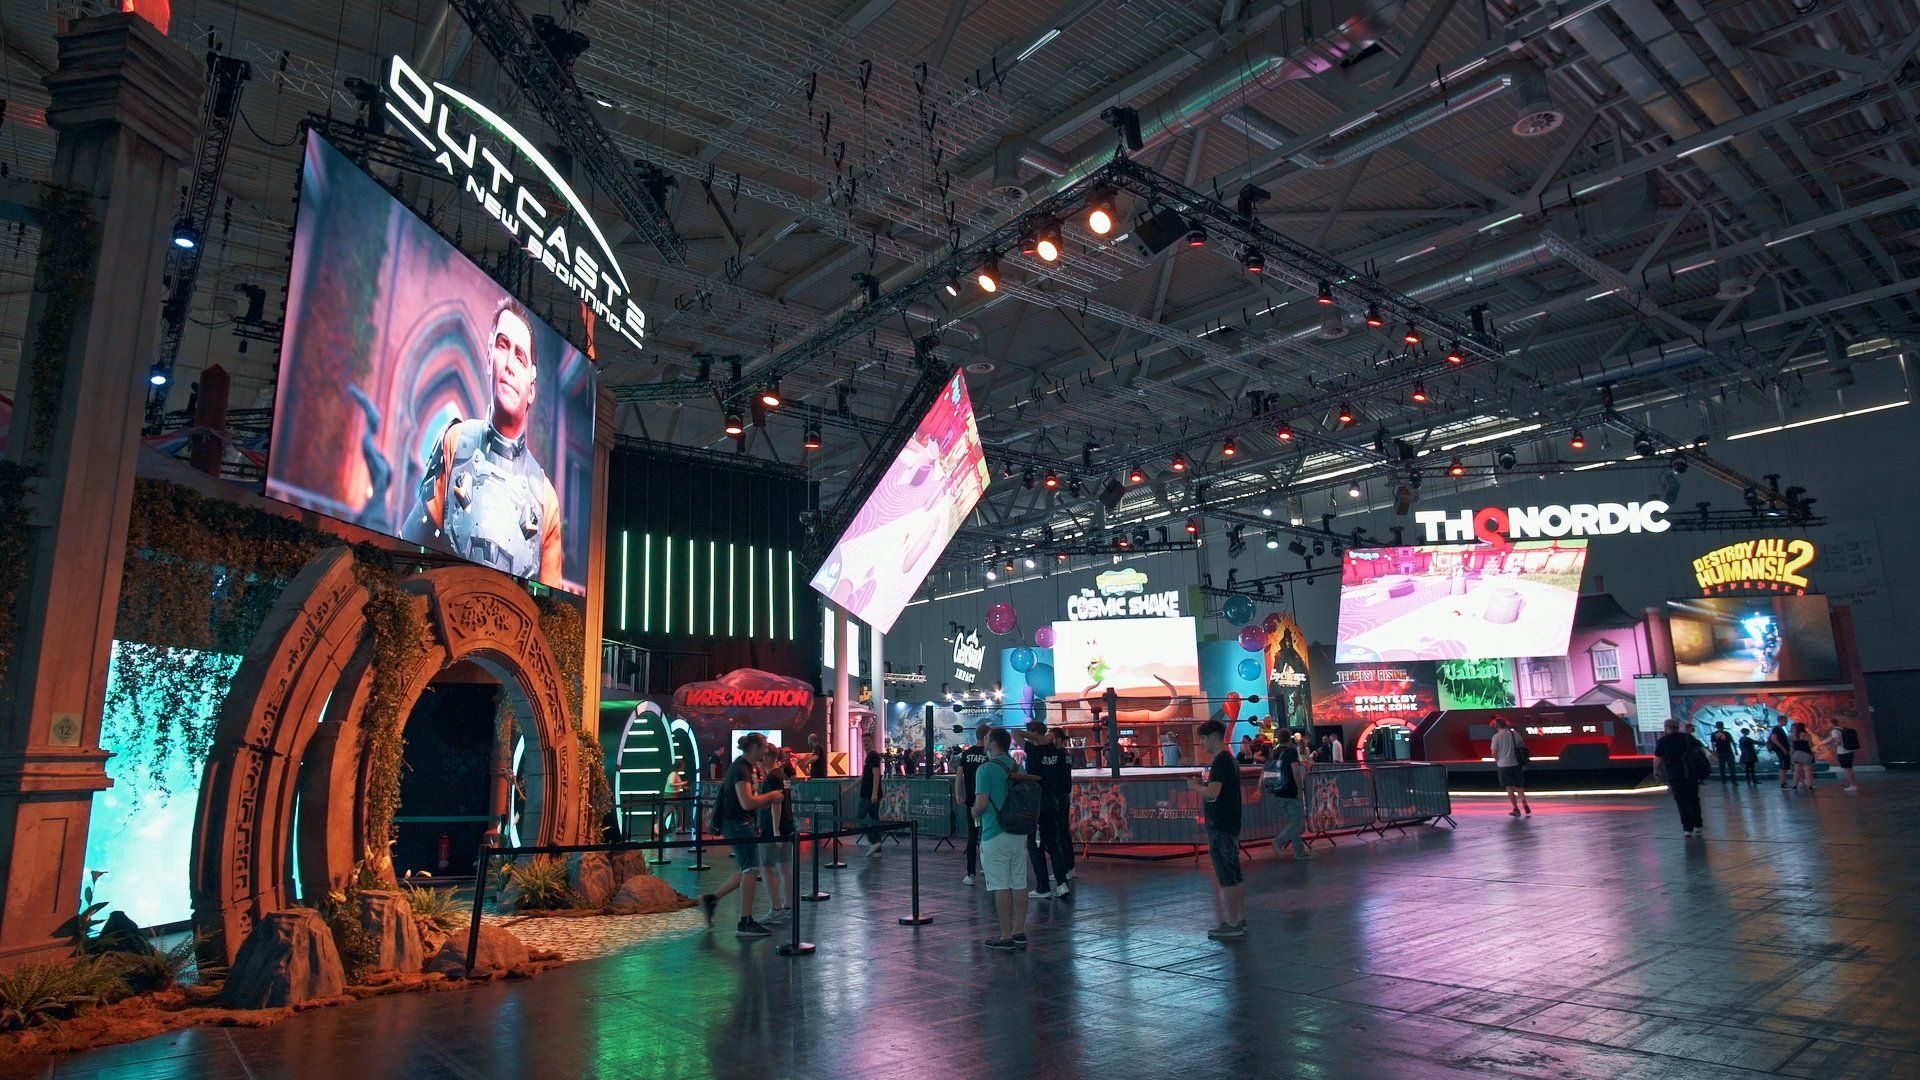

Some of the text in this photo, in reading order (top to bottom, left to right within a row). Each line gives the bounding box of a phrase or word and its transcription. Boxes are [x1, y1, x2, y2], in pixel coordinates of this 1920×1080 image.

[389, 54, 645, 338] OUTCAST 2
[435, 151, 454, 176] A
[466, 175, 519, 236] NEW
[1693, 538, 1787, 574] DESTROY ALL
[1696, 539, 1815, 589] HUMANS! 2
[1703, 581, 1806, 597] REPROBED
[1067, 590, 1180, 621] COSMIC SHAKE
[954, 667, 976, 684] IMPACT
[1336, 669, 1408, 682] TEMPEST RISING
[685, 688, 810, 707] WRECKREATION
[1354, 694, 1417, 704] STRATEGY
[1355, 703, 1418, 713] GAME ZONE
[58, 724, 72, 736] 12
[966, 754, 987, 763] STAFF
